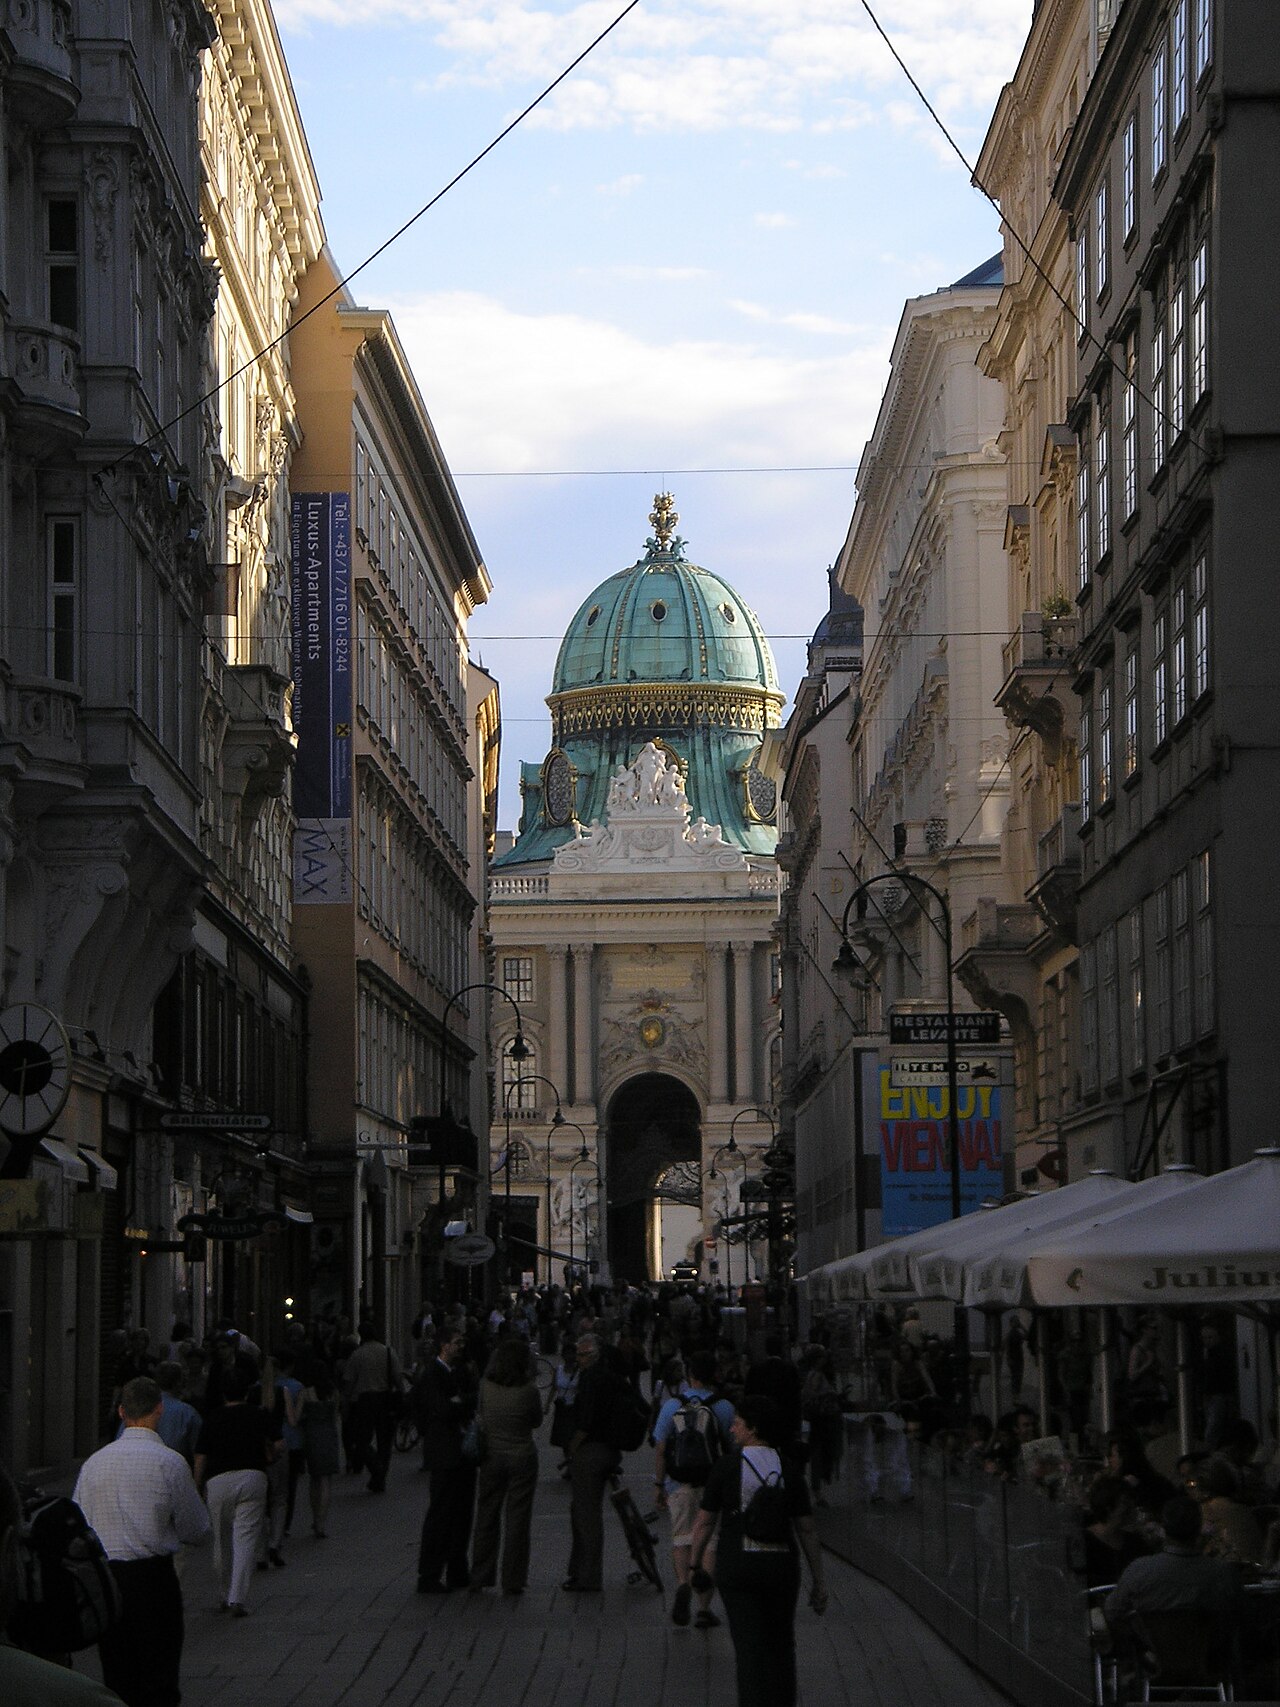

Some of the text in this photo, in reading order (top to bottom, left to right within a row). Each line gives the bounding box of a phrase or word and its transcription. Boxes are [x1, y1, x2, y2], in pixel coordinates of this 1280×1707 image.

[294, 501, 303, 511] in
[334, 501, 349, 528] Tel.:
[292, 514, 303, 557] Eigentum
[293, 560, 300, 575] am
[304, 501, 322, 660] Luxus-Apartments
[292, 578, 303, 627] exklusiven
[293, 630, 302, 662] Wiener
[293, 828, 328, 895] MAX
[909, 1062, 969, 1073] TEMO
